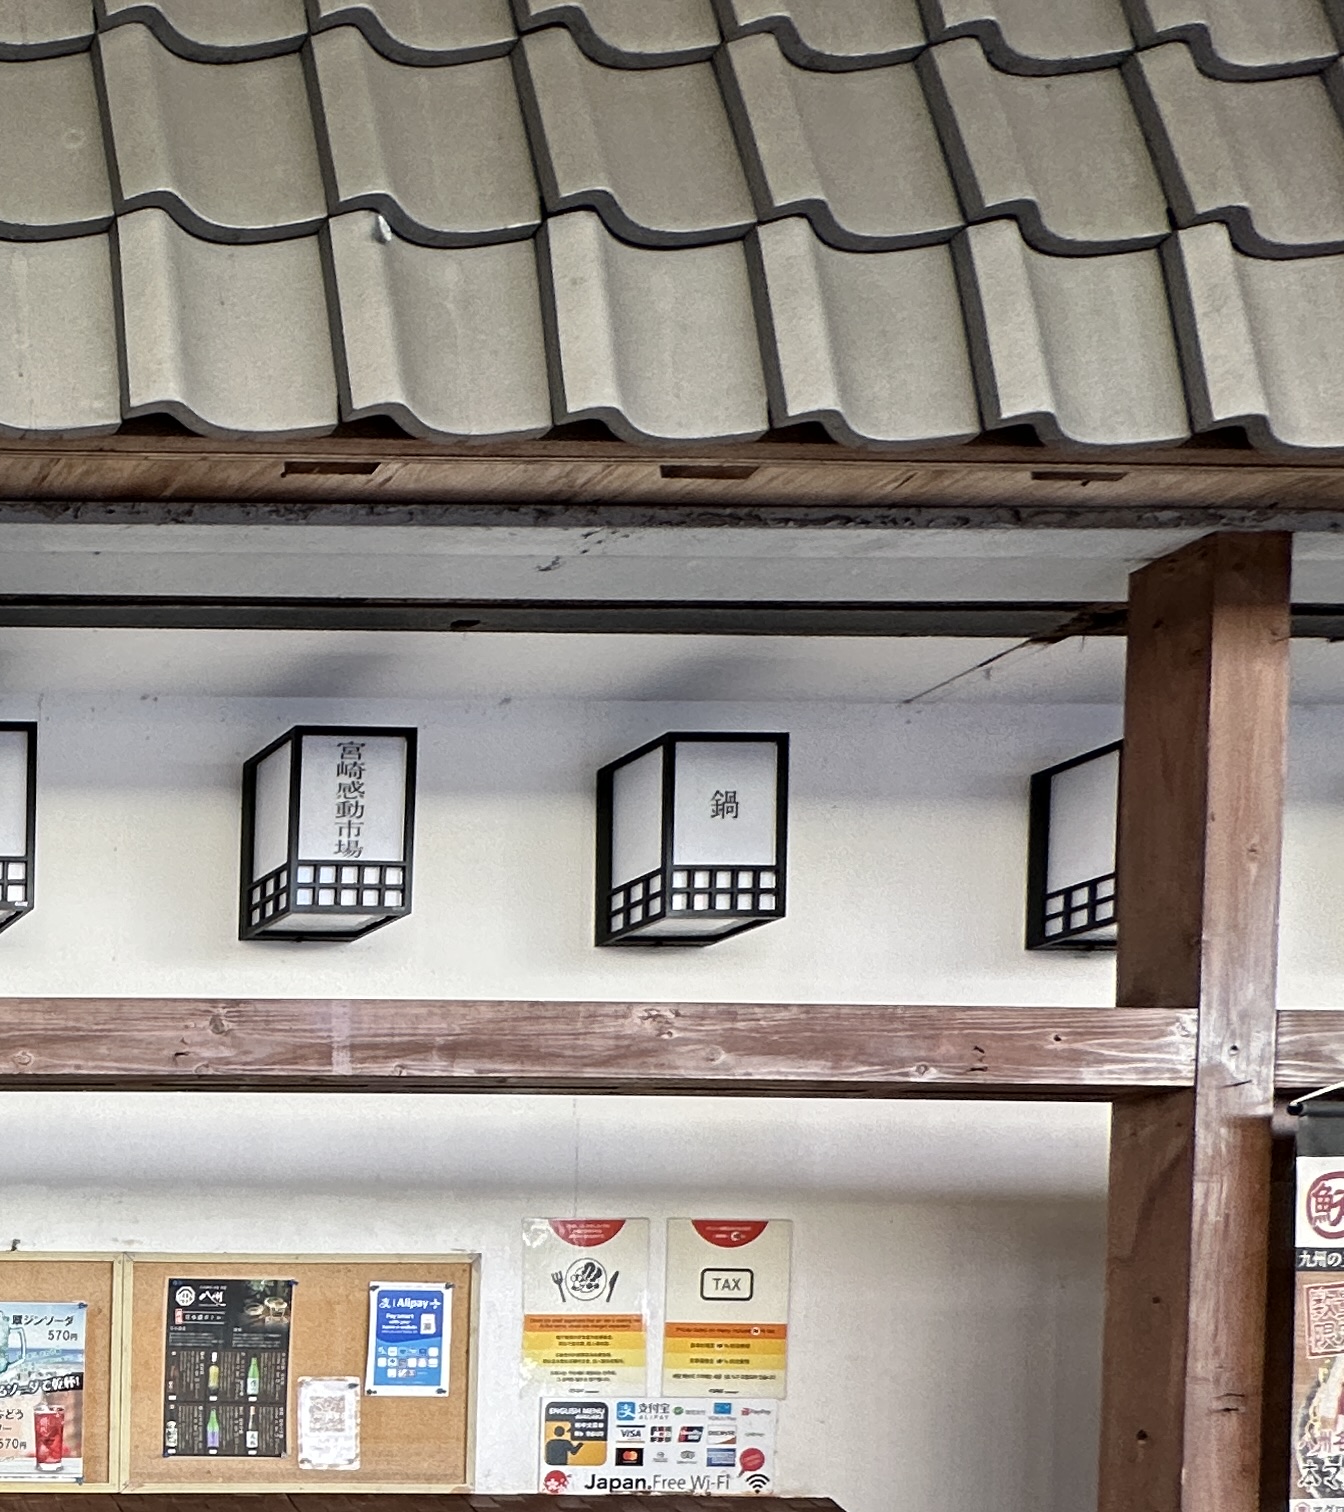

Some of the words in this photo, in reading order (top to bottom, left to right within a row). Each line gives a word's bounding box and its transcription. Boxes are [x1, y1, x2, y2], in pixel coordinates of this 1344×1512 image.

[333, 740, 366, 858] 宮崎感動市場
[710, 789, 739, 819] 鍋
[1298, 1252, 1344, 1270] 九州の
[713, 1278, 742, 1292] TAX
[48, 1330, 78, 1342] 570円
[639, 1403, 670, 1413] 支付宝
[621, 1430, 642, 1438] VISA
[691, 1474, 731, 1491] Wi-Fi
